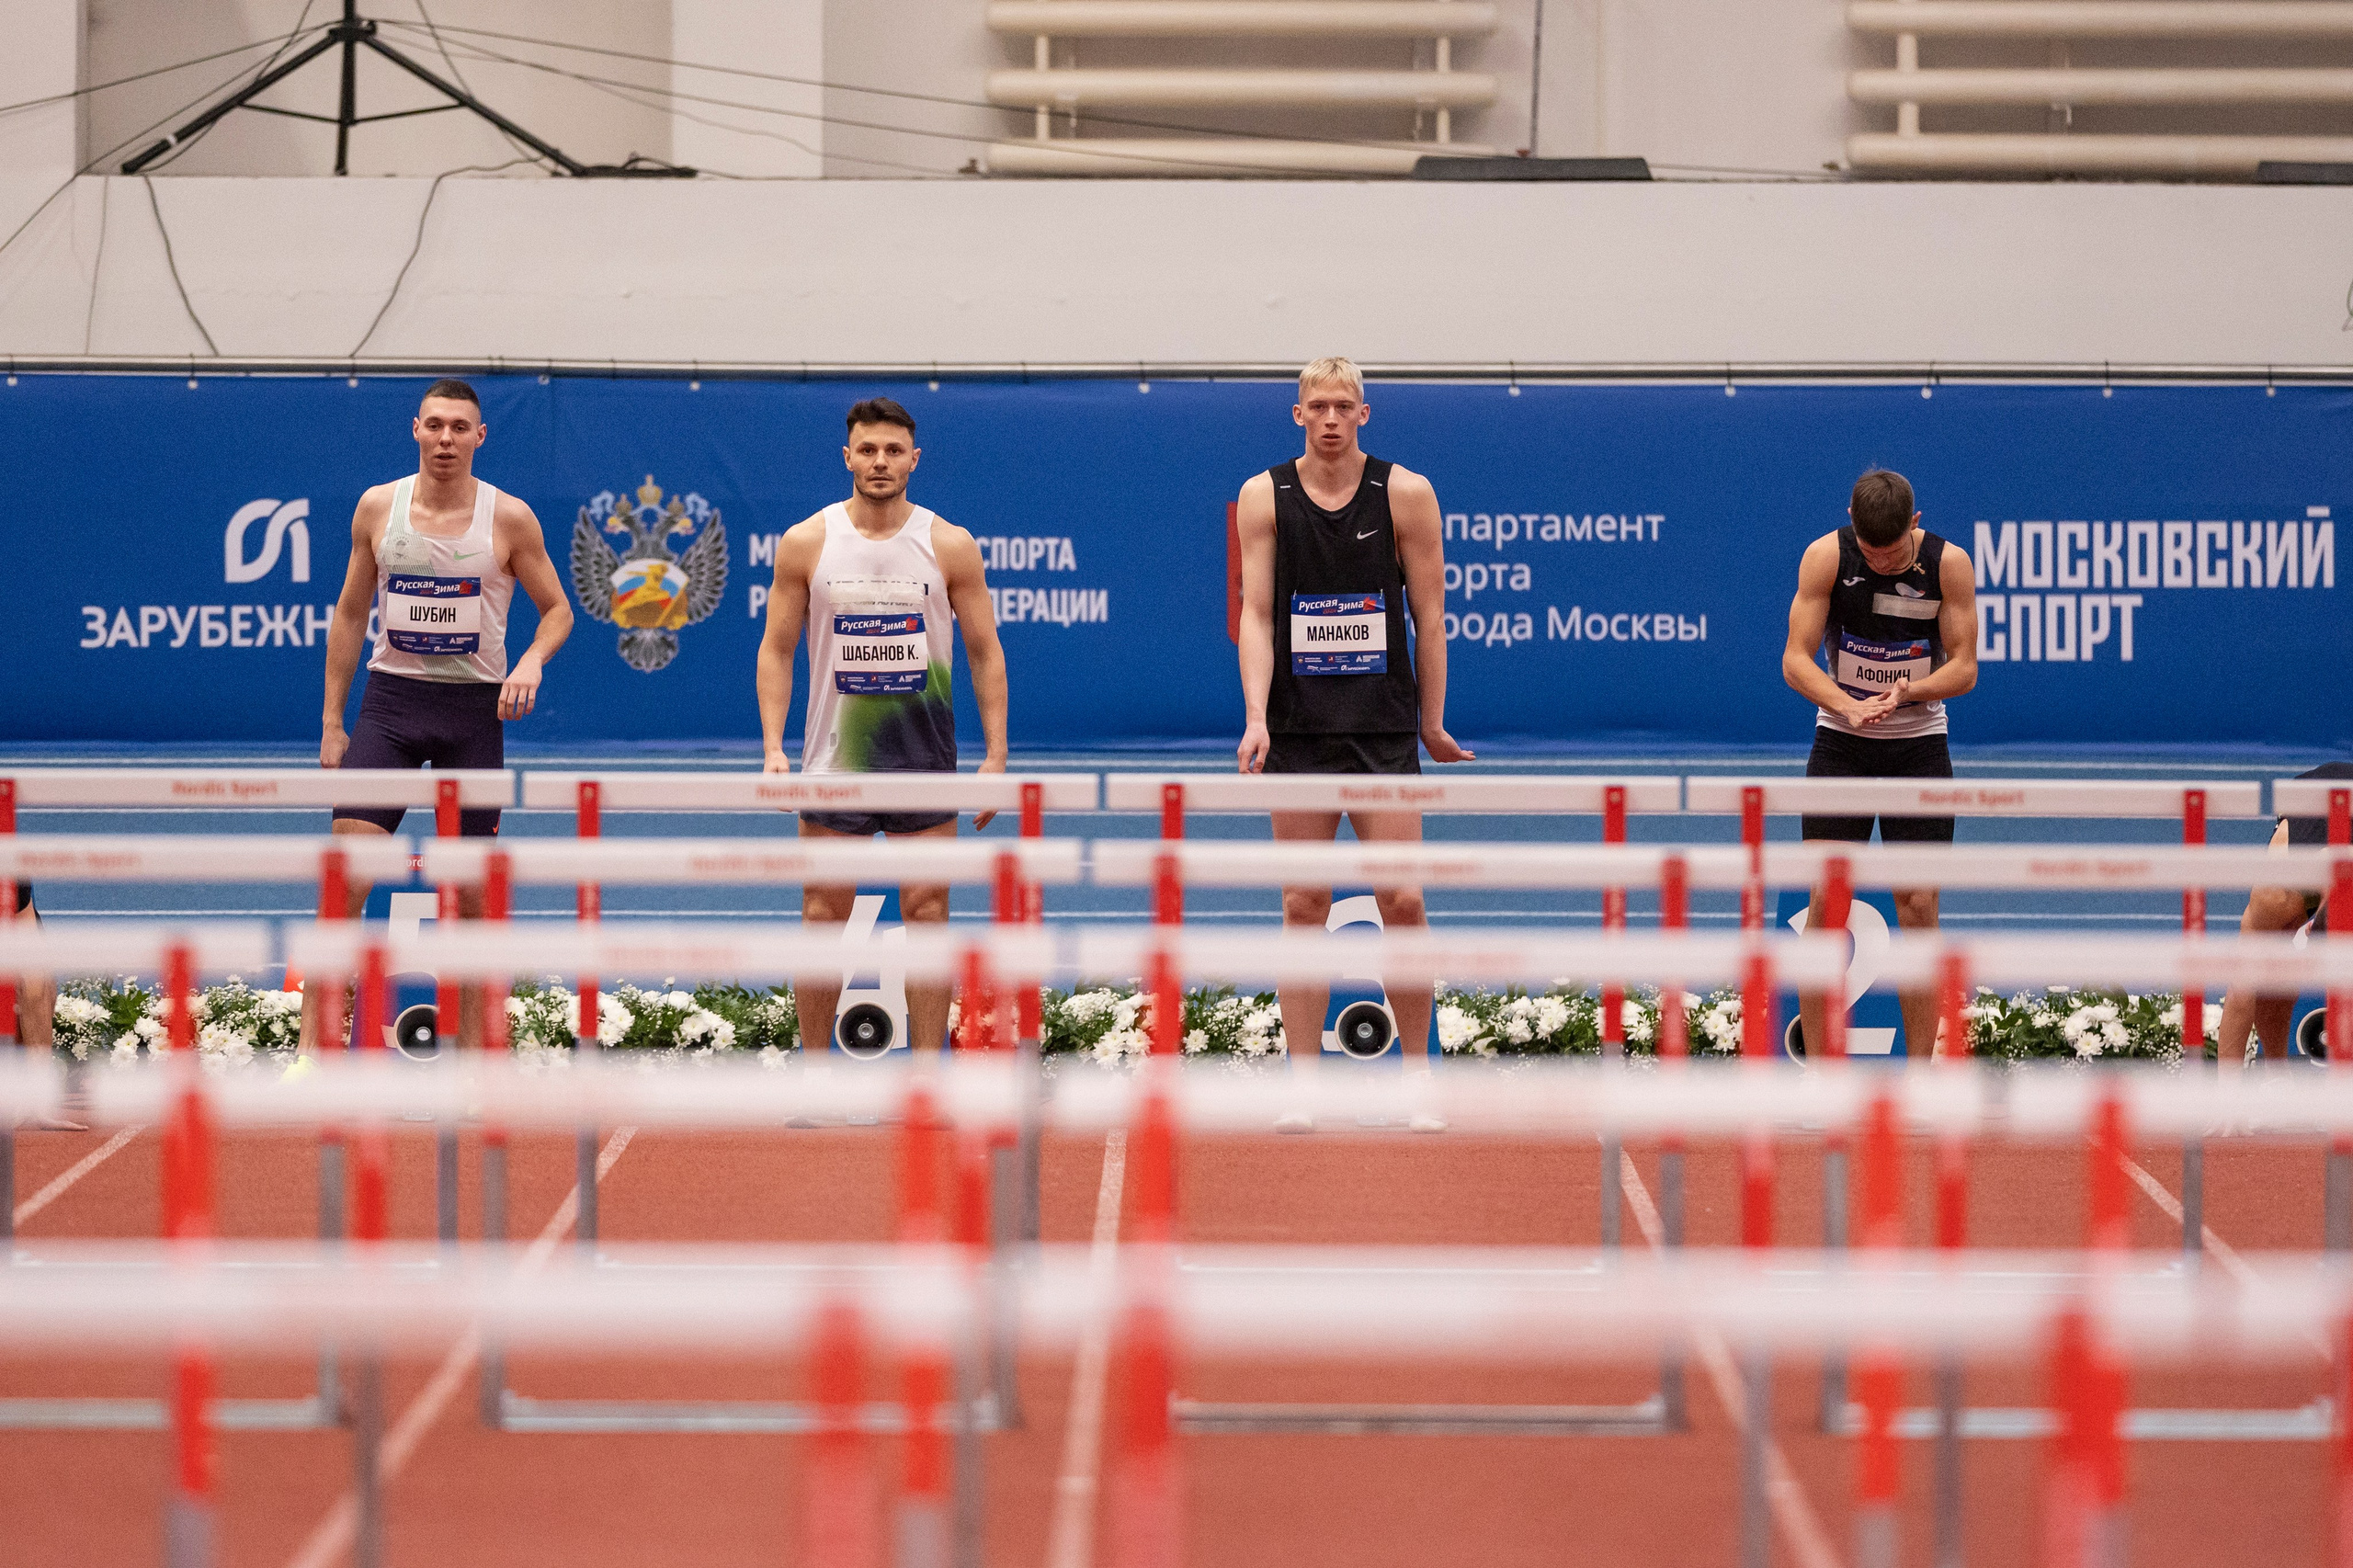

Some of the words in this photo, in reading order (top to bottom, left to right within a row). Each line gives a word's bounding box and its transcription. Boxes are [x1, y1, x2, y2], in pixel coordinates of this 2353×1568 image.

[1444, 513, 1665, 551] партамент
[1973, 506, 2335, 588] МОСКОВСКИЙ
[395, 580, 435, 592] Русская
[1444, 562, 1531, 600] орта
[409, 605, 457, 623] ШУБИН
[1298, 599, 1338, 612] Русская
[80, 605, 335, 649] ЗАРУБЕЖН
[840, 619, 881, 632] Русская
[1306, 624, 1370, 642] МАНАКОВ
[1547, 606, 1708, 642] Москвы
[1976, 594, 2143, 662] СПОРТ
[842, 645, 904, 662] ШАБАНОВ
[907, 644, 919, 661] К.
[1846, 641, 1885, 654] Русская
